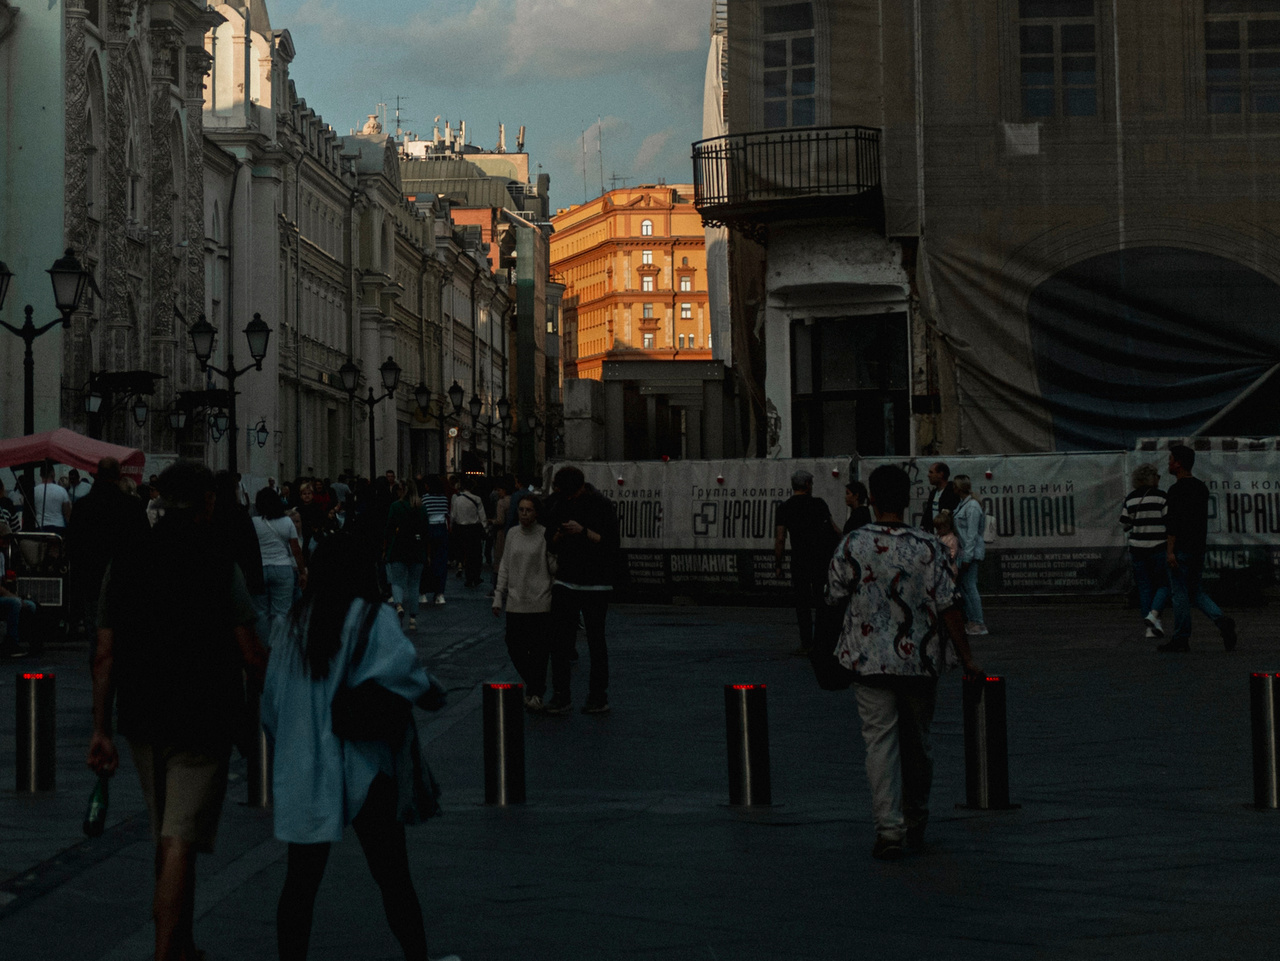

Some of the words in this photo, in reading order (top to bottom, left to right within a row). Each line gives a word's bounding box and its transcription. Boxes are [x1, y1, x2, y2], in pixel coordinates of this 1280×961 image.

[691, 485, 736, 499] Группа
[979, 480, 1075, 494] компаний
[670, 553, 738, 573] ВНИМАНИЕ!
